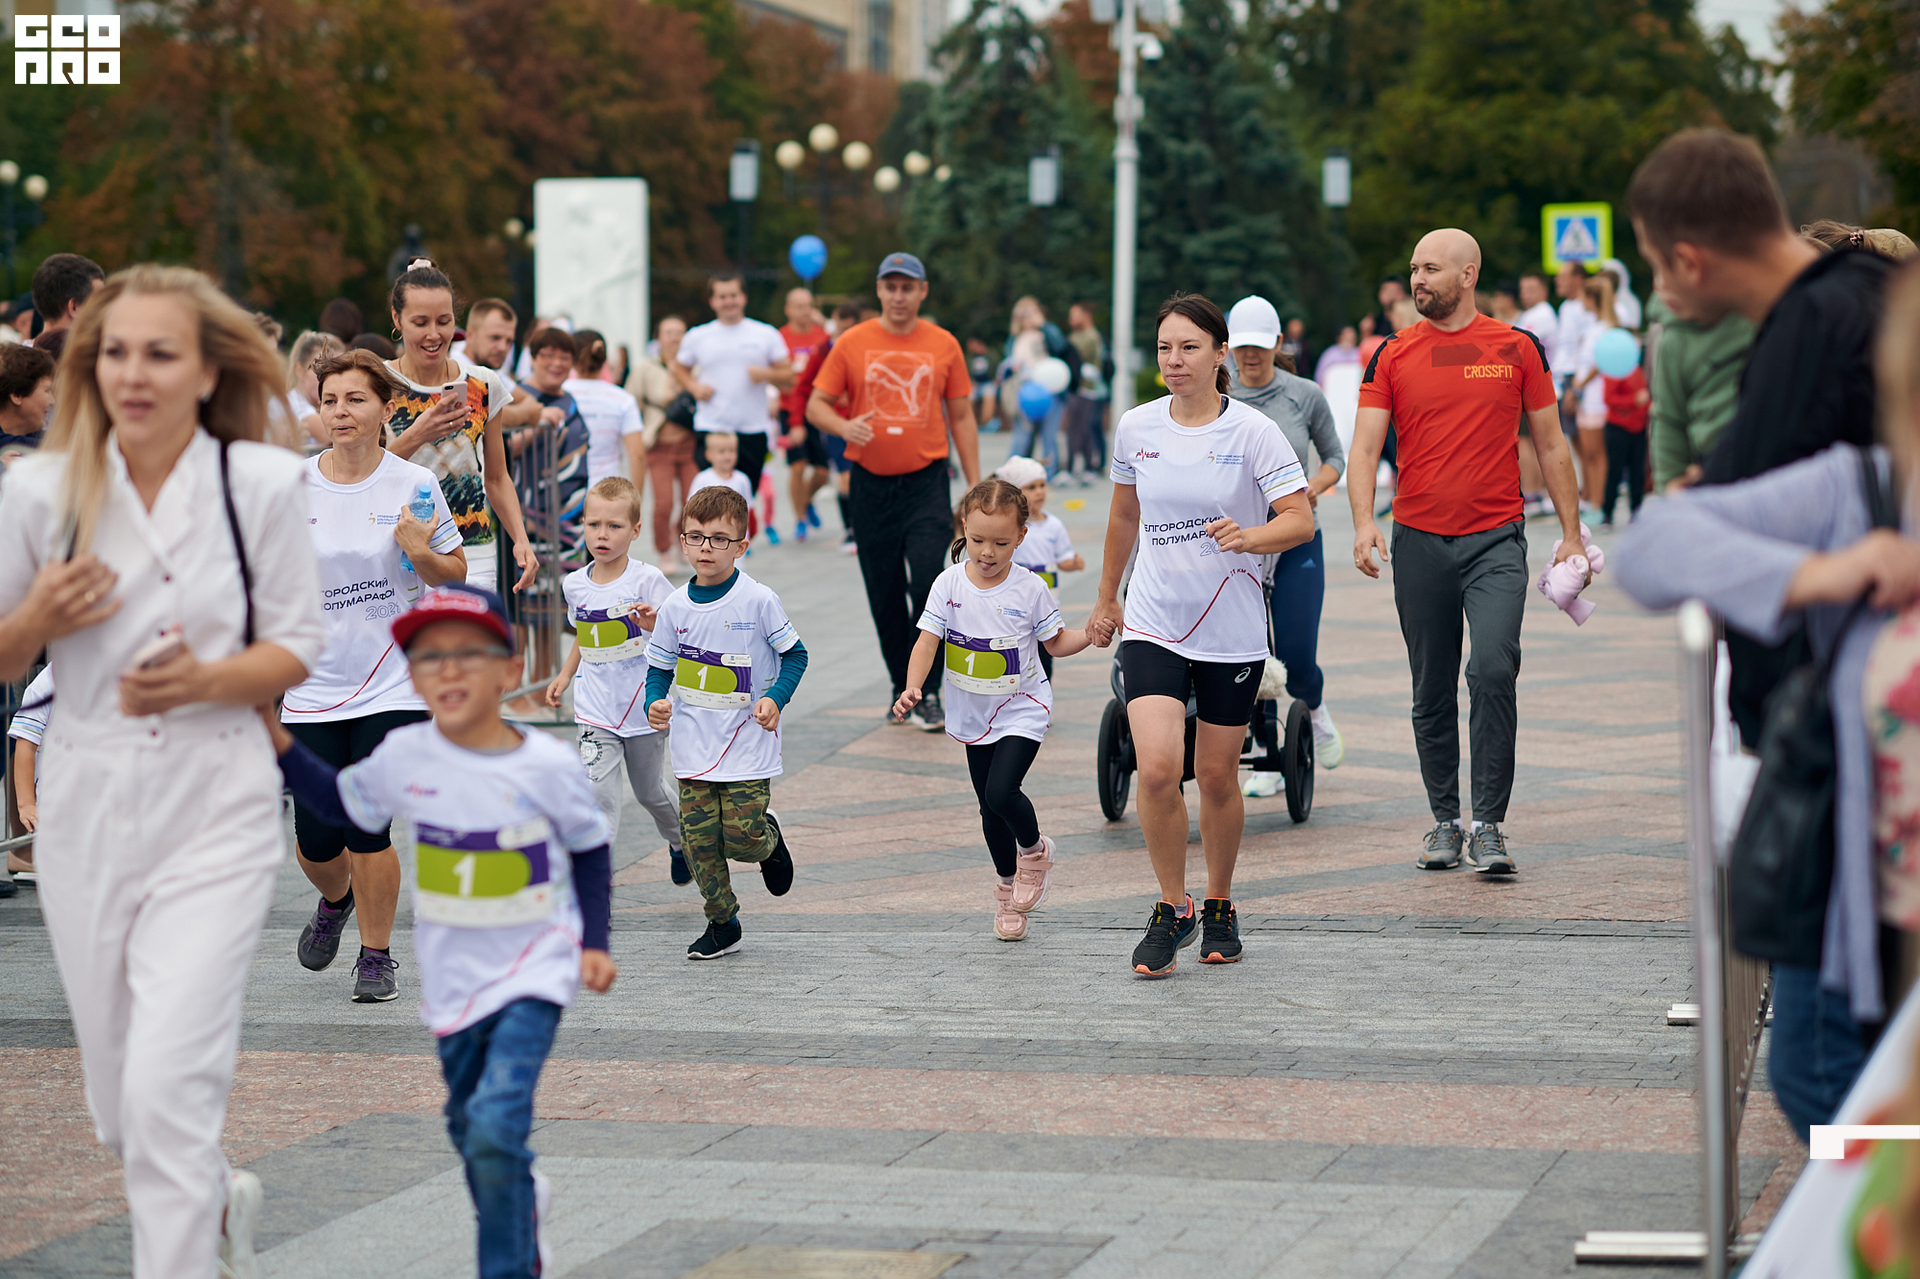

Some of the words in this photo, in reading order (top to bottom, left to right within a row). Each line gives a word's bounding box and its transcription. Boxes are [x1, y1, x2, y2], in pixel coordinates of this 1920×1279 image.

[1464, 365, 1513, 379] CROSSFIT
[1145, 515, 1224, 533] ЕЛГОРОДСКИ
[320, 577, 389, 598] ОРОДСКИЙ
[321, 588, 395, 611] ОЛУМАРАФО
[590, 624, 599, 647] 1
[964, 652, 976, 675] 1
[697, 666, 708, 690] 1
[452, 853, 476, 896] 1
